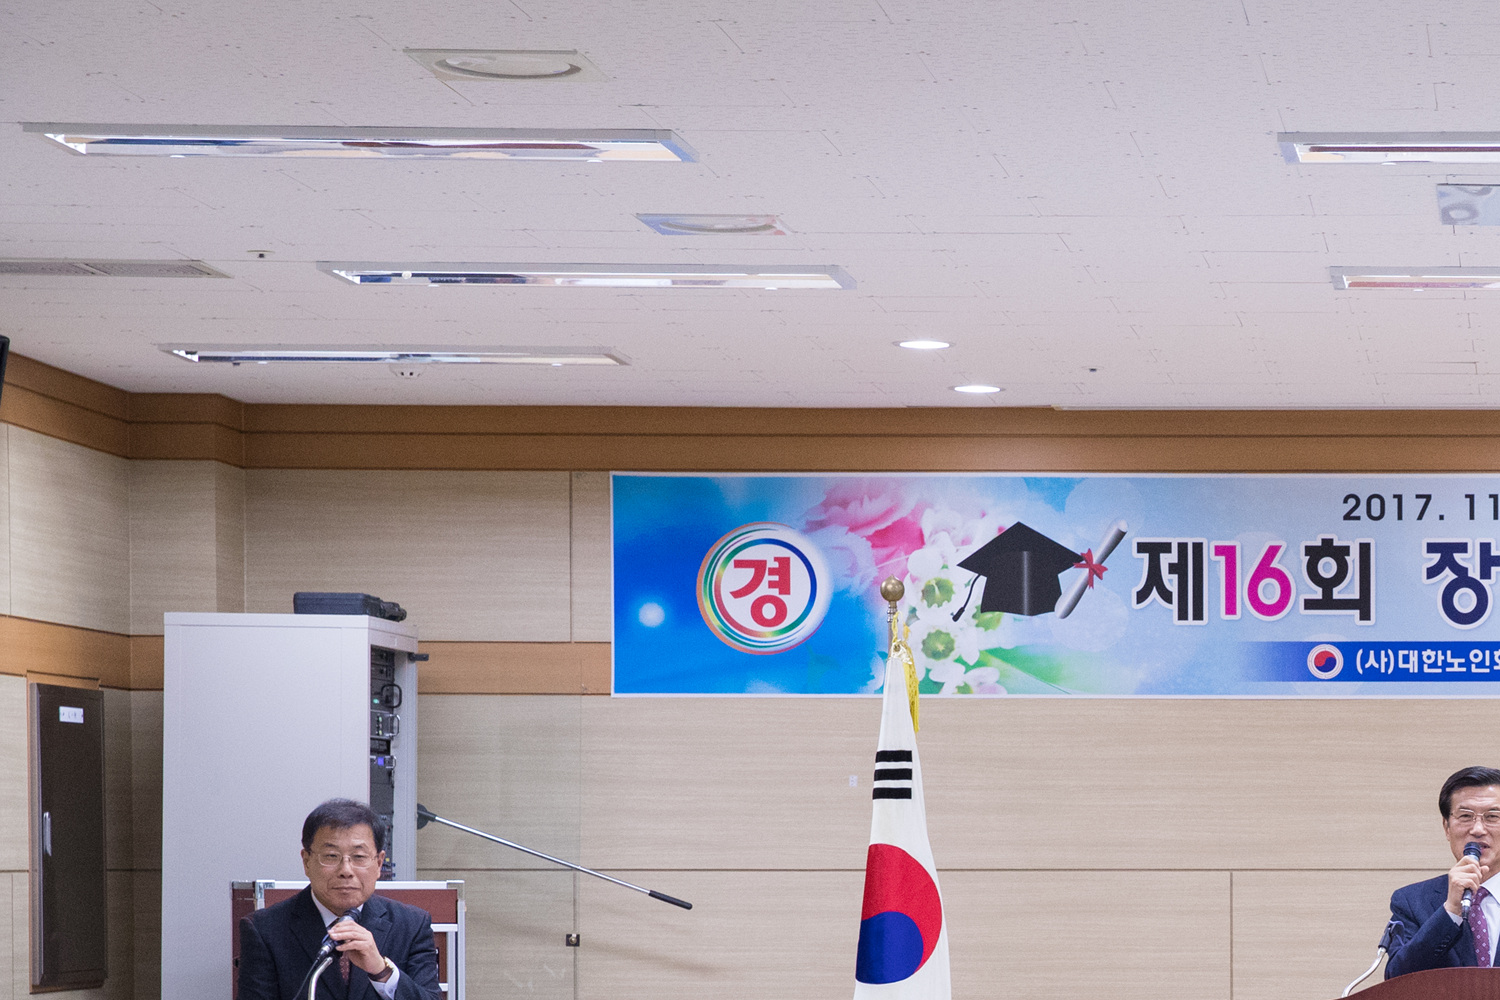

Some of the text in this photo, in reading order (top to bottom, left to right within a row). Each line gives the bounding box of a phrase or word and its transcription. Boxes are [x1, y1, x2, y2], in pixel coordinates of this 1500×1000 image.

[1342, 493, 1445, 522] 2017.
[728, 556, 791, 628] 경
[1136, 537, 1371, 621] 제16회
